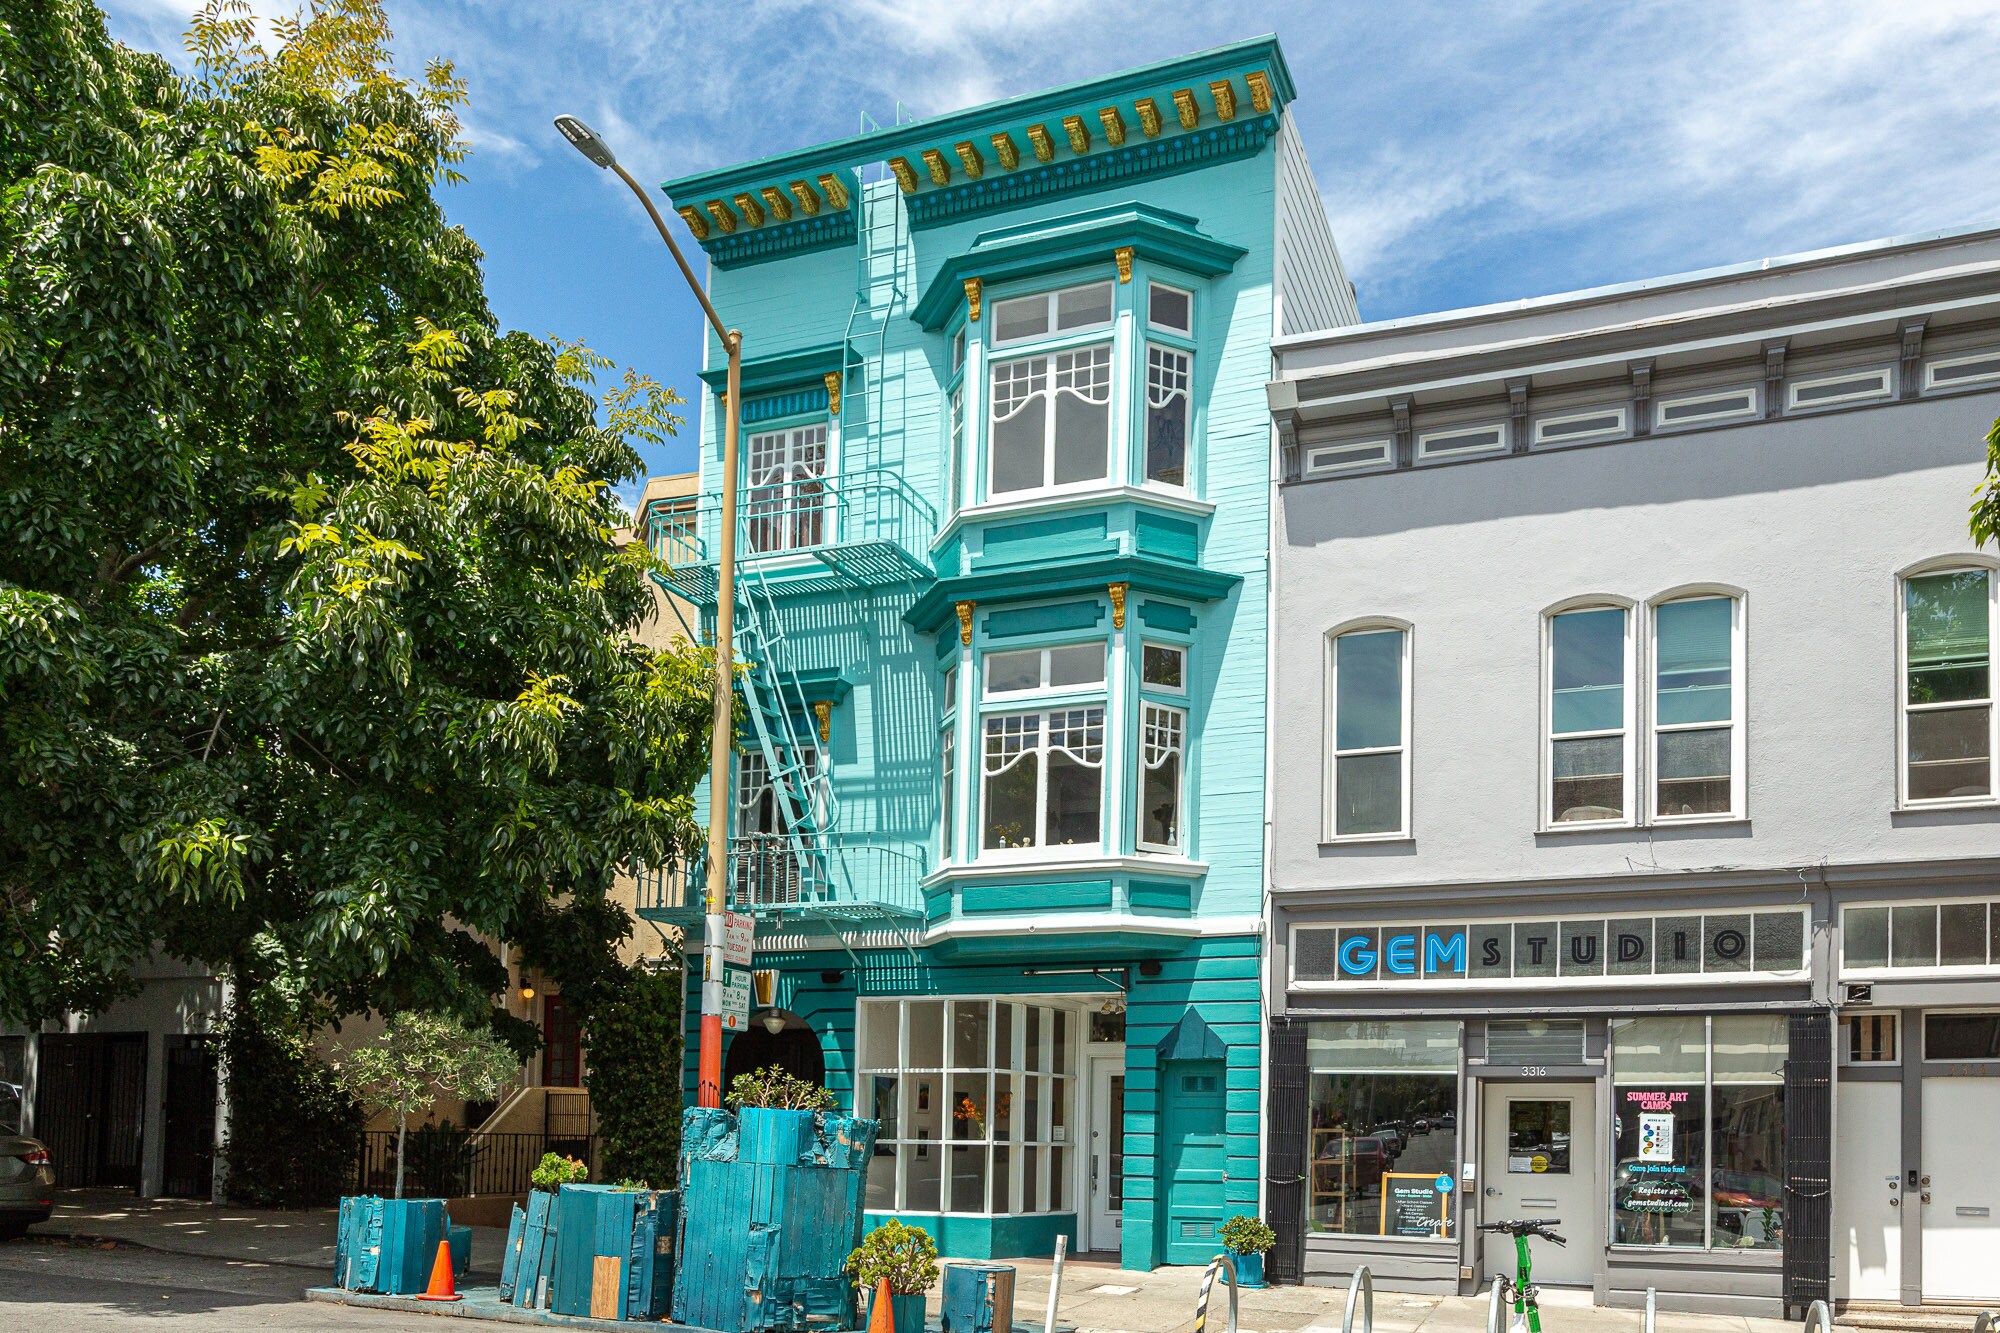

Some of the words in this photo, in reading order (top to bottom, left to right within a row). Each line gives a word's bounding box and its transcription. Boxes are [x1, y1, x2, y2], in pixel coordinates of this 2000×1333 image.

[734, 918, 752, 931] PARKING
[726, 942, 747, 954] TUESDAY
[1338, 932, 1466, 975] GEM
[1482, 929, 1746, 967] STUDIO
[734, 975, 747, 983] HOUR
[731, 981, 749, 991] PARKING
[1521, 1066, 1547, 1077] 3316
[1626, 1091, 1667, 1102] SUMMER
[1668, 1092, 1689, 1102] ART
[1640, 1100, 1673, 1110] CAMPS
[1628, 1164, 1647, 1172] Come
[1660, 1165, 1671, 1173] the
[1672, 1165, 1686, 1173] fun!
[1638, 1186, 1668, 1196] Register
[1627, 1199, 1689, 1208] gemstudiosf.com
[1416, 1217, 1455, 1227] Create
